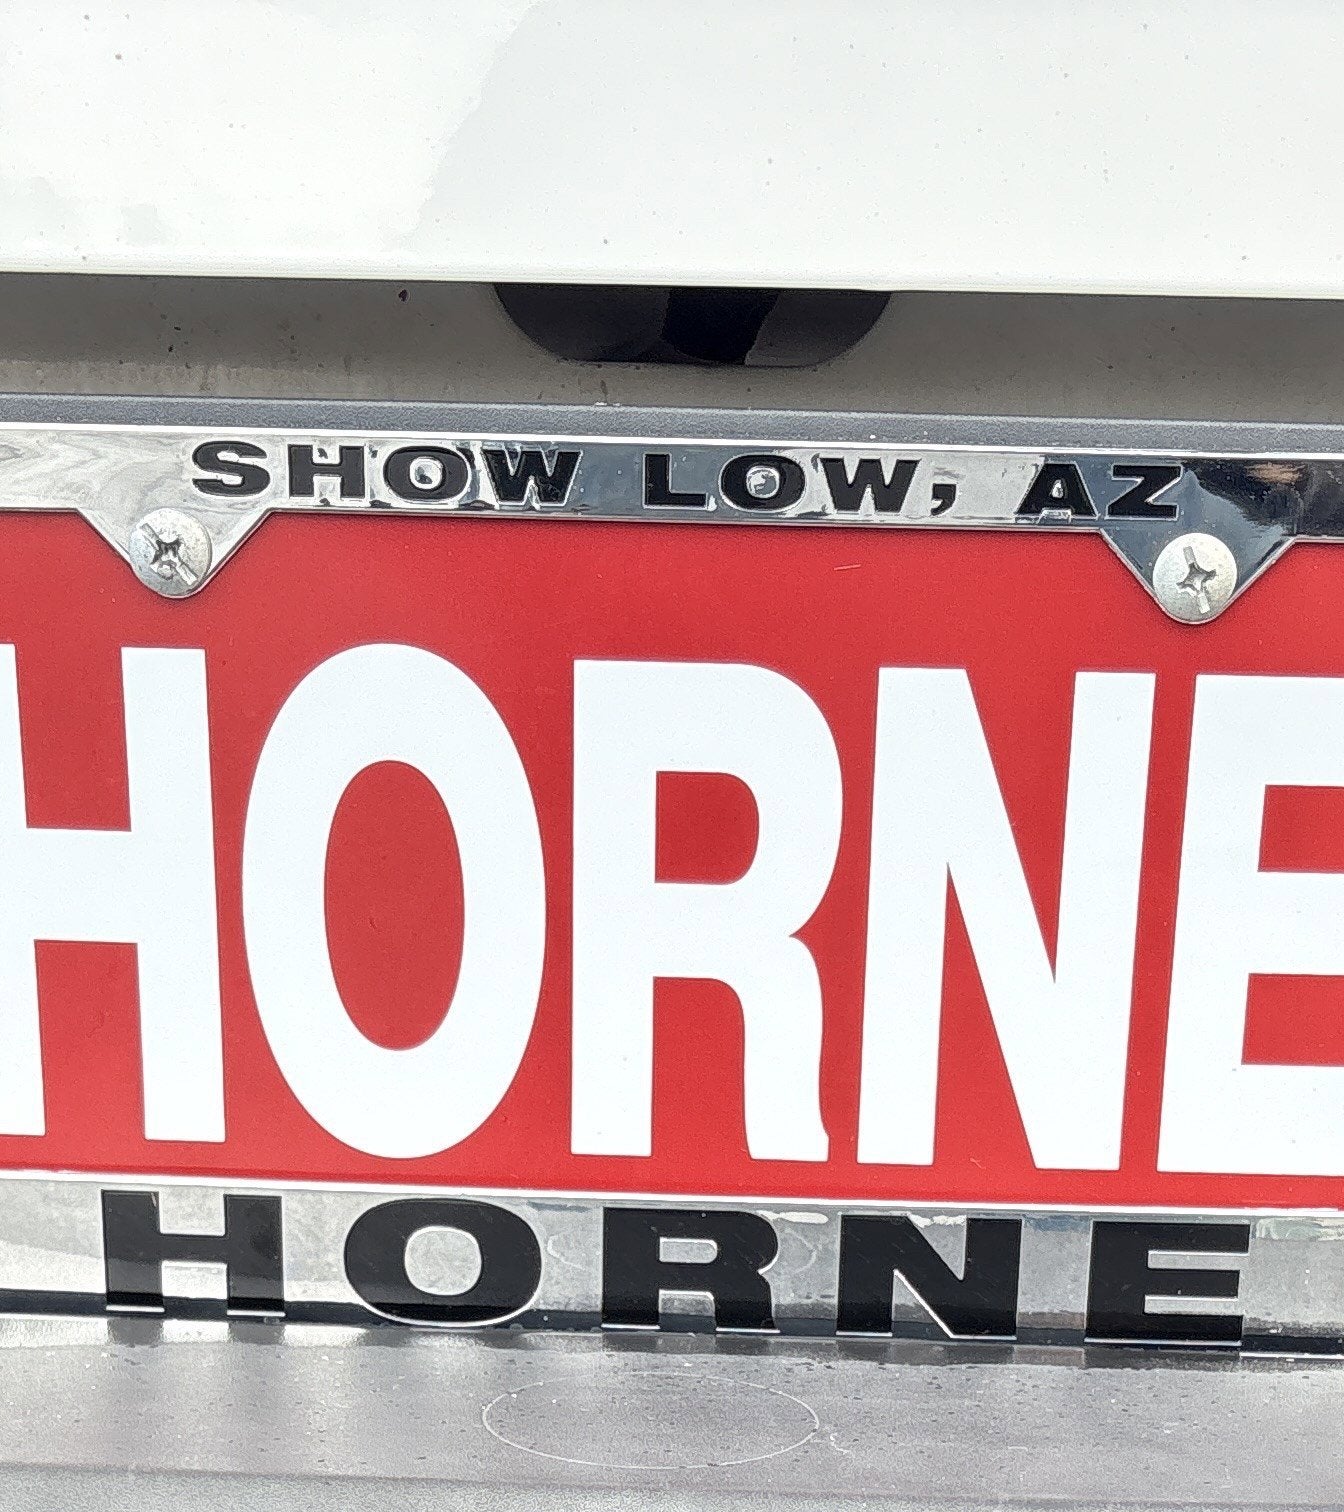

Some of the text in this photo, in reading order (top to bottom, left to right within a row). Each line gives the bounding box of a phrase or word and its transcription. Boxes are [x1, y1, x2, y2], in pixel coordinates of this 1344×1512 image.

[191, 440, 1182, 520] SHOW LOW, AZ
[99, 1188, 1253, 1345] HORNE
